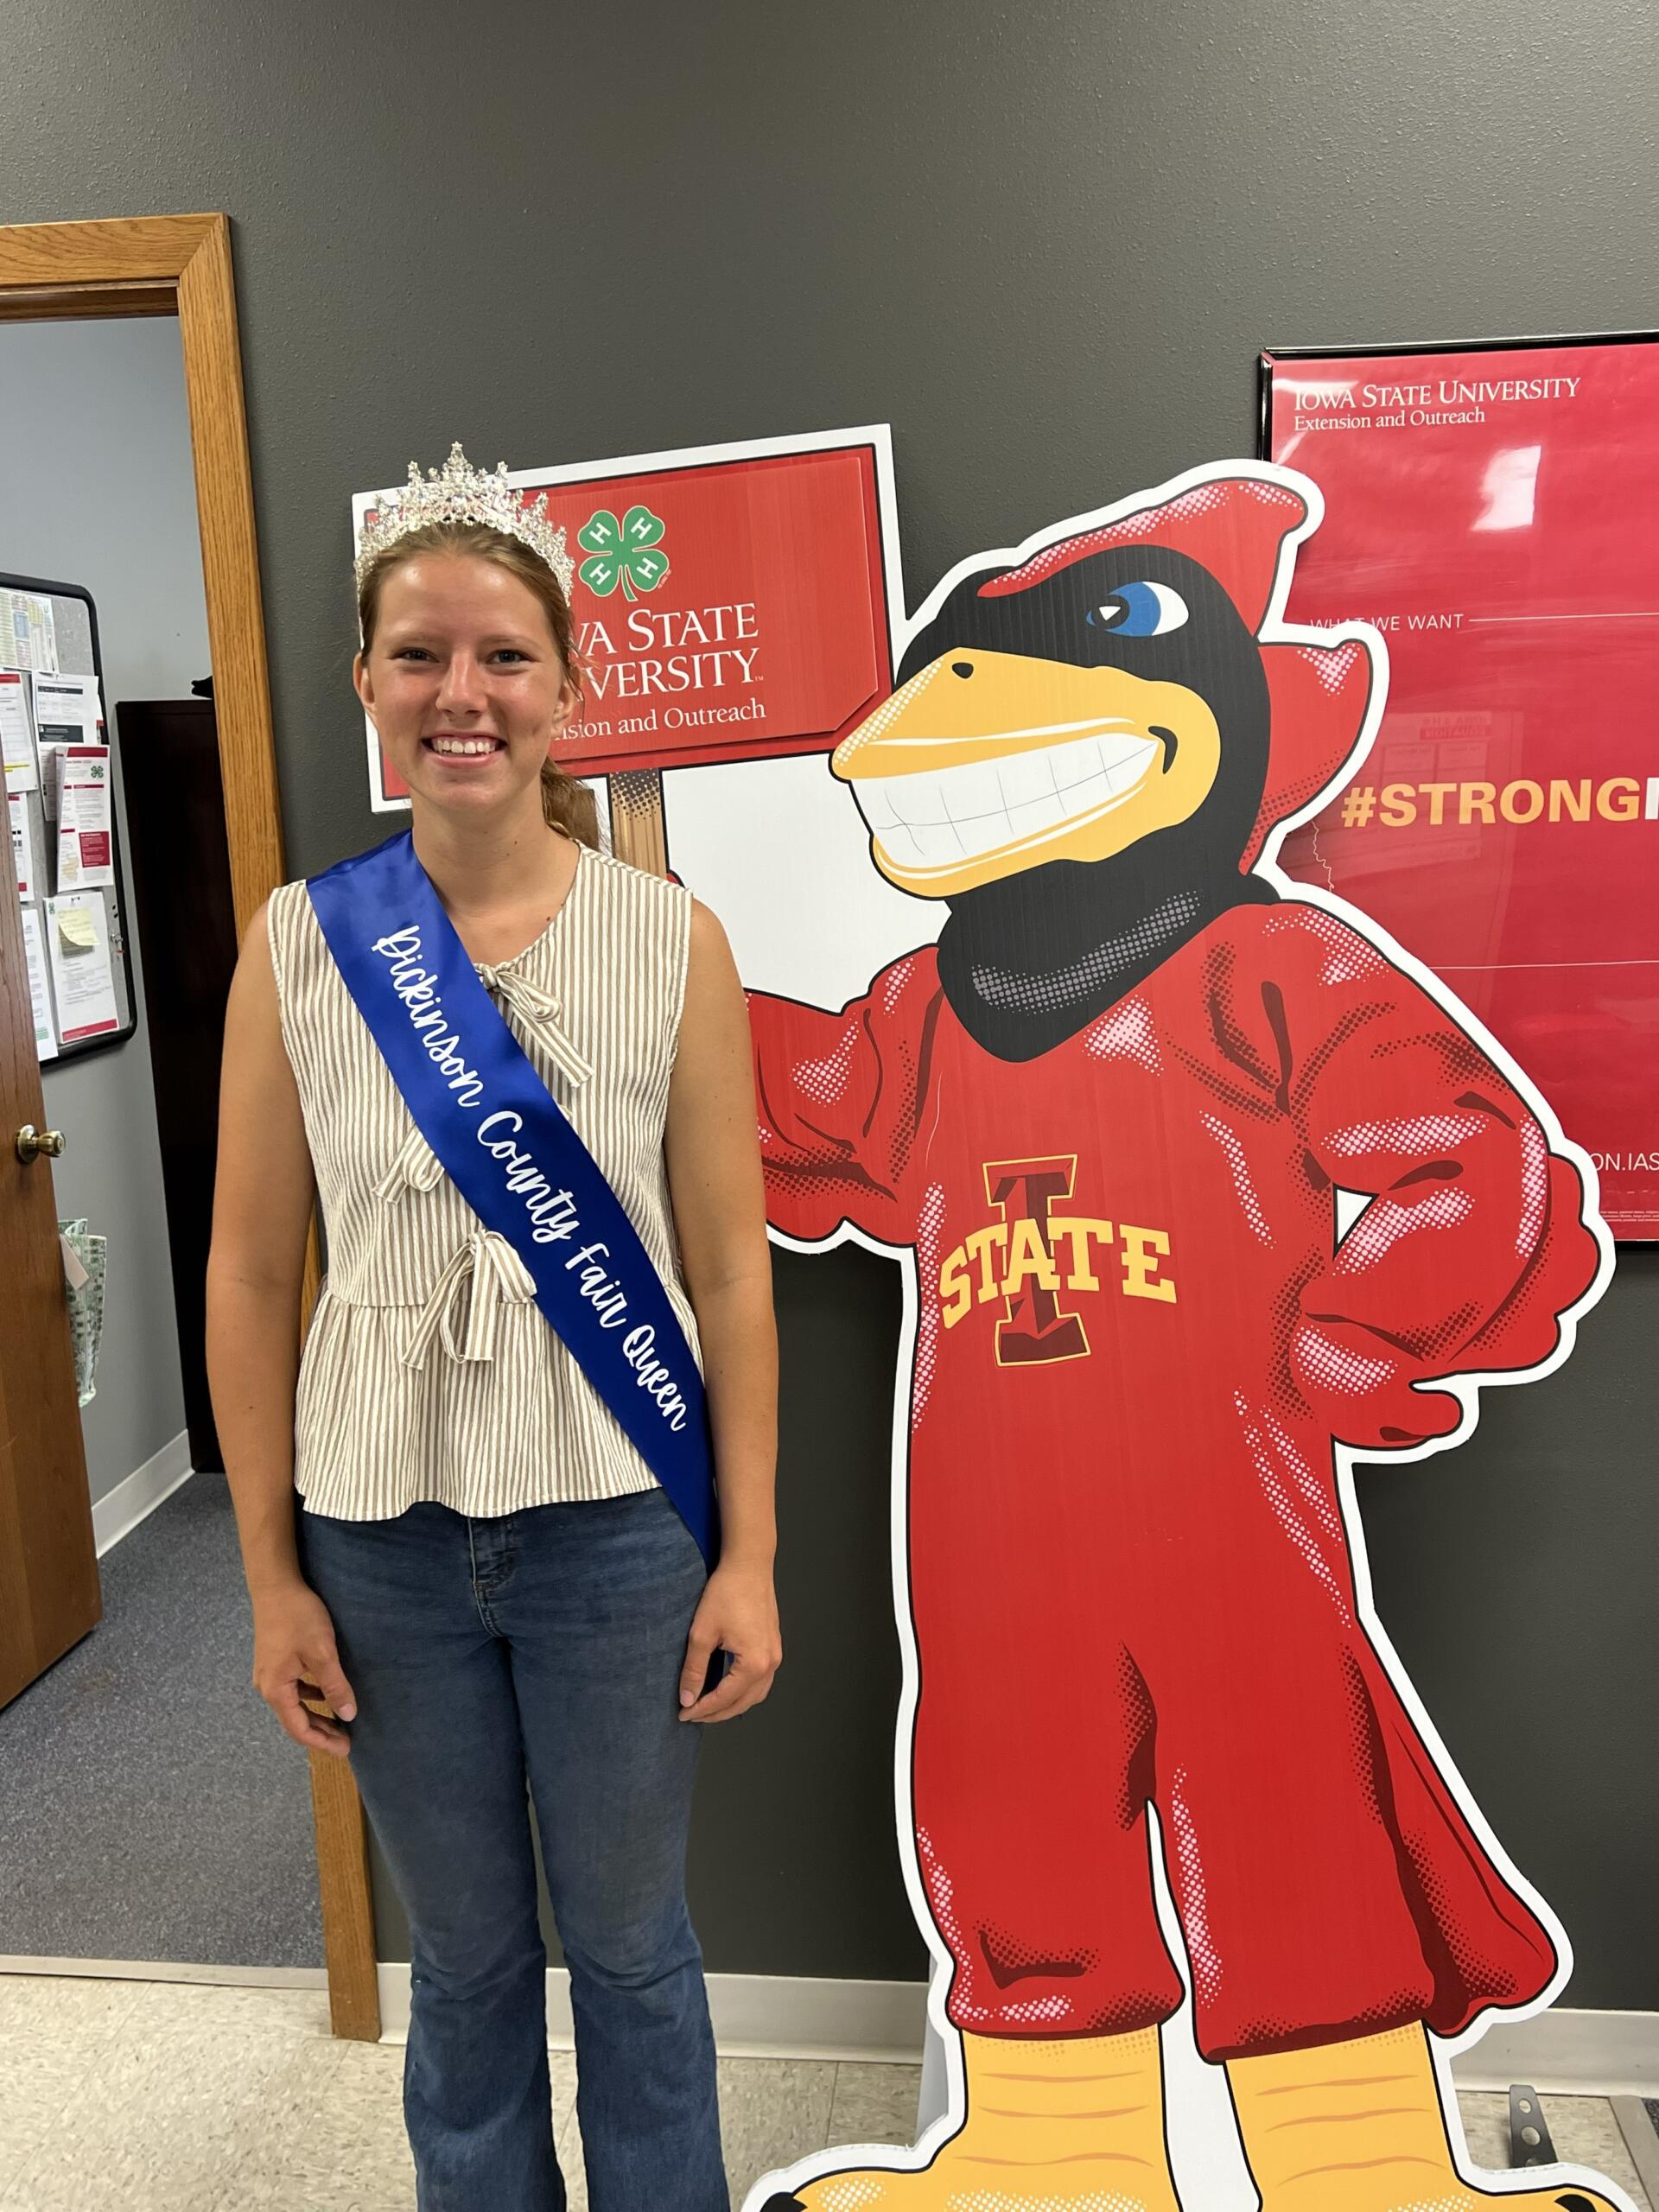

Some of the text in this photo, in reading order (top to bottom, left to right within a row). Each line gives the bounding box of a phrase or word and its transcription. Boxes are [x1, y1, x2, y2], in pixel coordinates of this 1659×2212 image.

[1294, 378, 1581, 410] IOWA STATE UNIVERSITY
[1294, 408, 1486, 432] Extension and Outreach
[627, 602, 759, 652] STATE
[1370, 616, 1401, 632] WE
[1408, 613, 1465, 631] WANT
[577, 647, 760, 702] VERSITY
[618, 709, 659, 734] and
[664, 697, 767, 730] Outreach
[372, 925, 687, 1432] Dickinson County Fair Queen
[939, 1217, 1177, 1329] STATE
